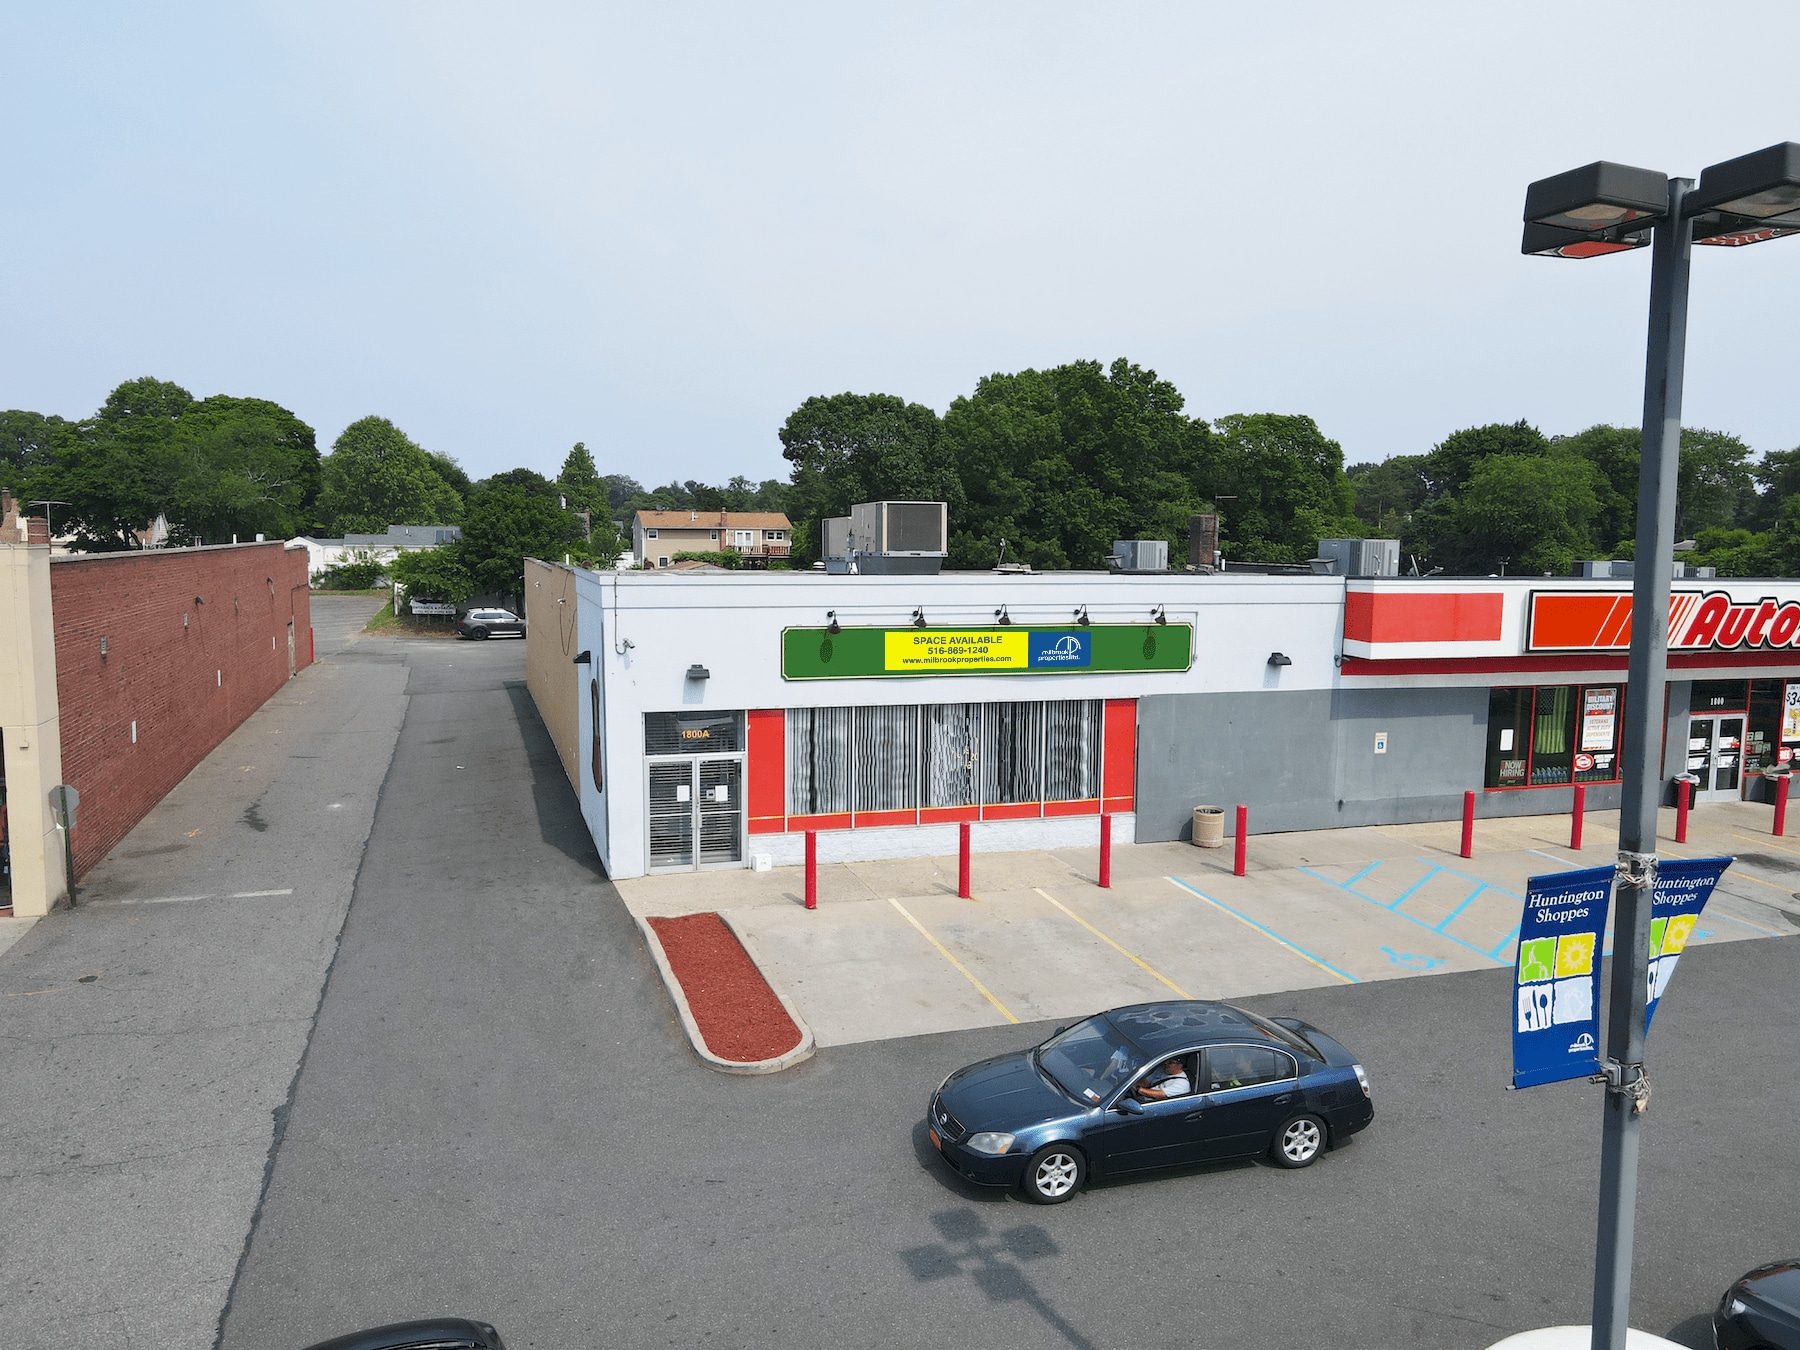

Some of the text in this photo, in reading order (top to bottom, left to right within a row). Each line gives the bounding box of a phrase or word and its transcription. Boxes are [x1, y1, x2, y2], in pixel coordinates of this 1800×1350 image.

[1681, 597, 1800, 646] Auto
[913, 635, 1003, 645] SPACE AVAILABLE
[927, 646, 989, 655] 516-869-1240
[902, 656, 1012, 664] www.milbrookproperties.com
[681, 730, 710, 738] 1800A
[1505, 761, 1522, 769] NOW
[1500, 768, 1526, 777] HIRING
[1653, 876, 1715, 890] Huntington
[1528, 890, 1604, 908] Huntington
[1652, 891, 1698, 906] Shoppes
[1536, 907, 1589, 924] Shoppes
